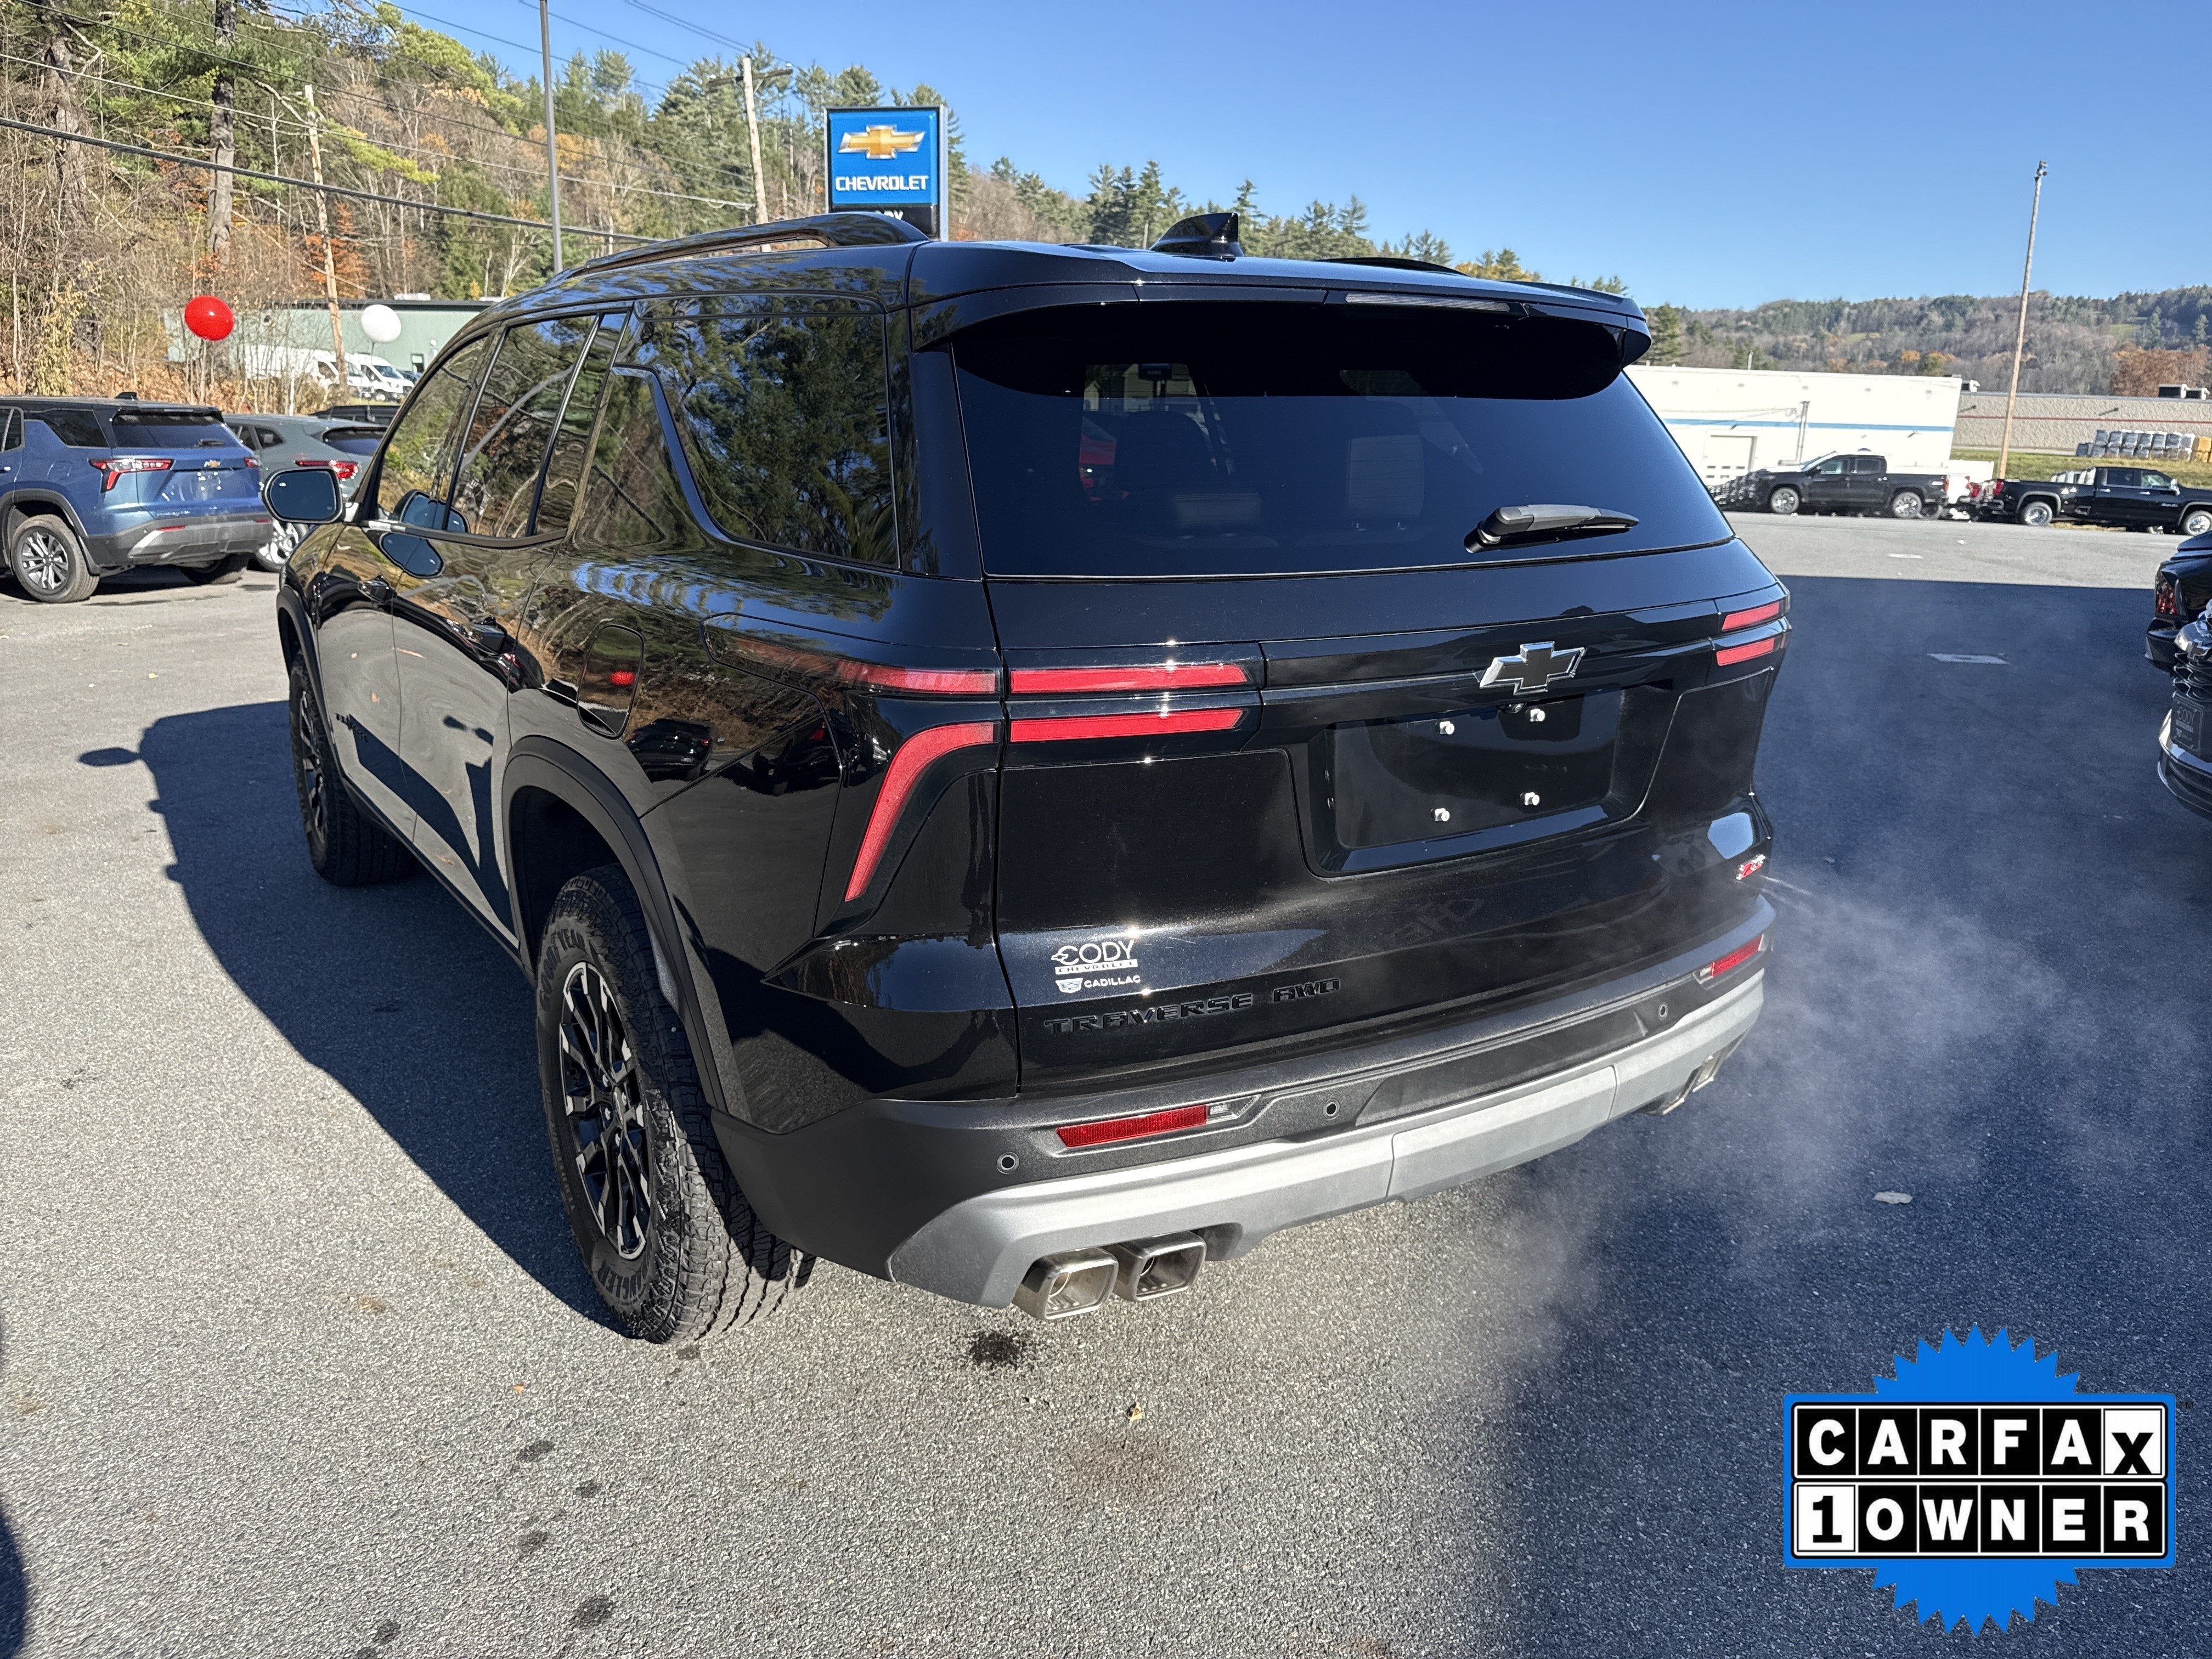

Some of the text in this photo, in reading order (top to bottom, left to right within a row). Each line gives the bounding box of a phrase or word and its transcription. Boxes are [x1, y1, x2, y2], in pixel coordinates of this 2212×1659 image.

[836, 175, 929, 191] CHEVROLET
[1051, 940, 1135, 966] CODY
[1058, 961, 1133, 973] CHEVROLET
[1084, 975, 1141, 988] CADILLAC
[1045, 978, 1340, 1034] TRAVERSE AWD
